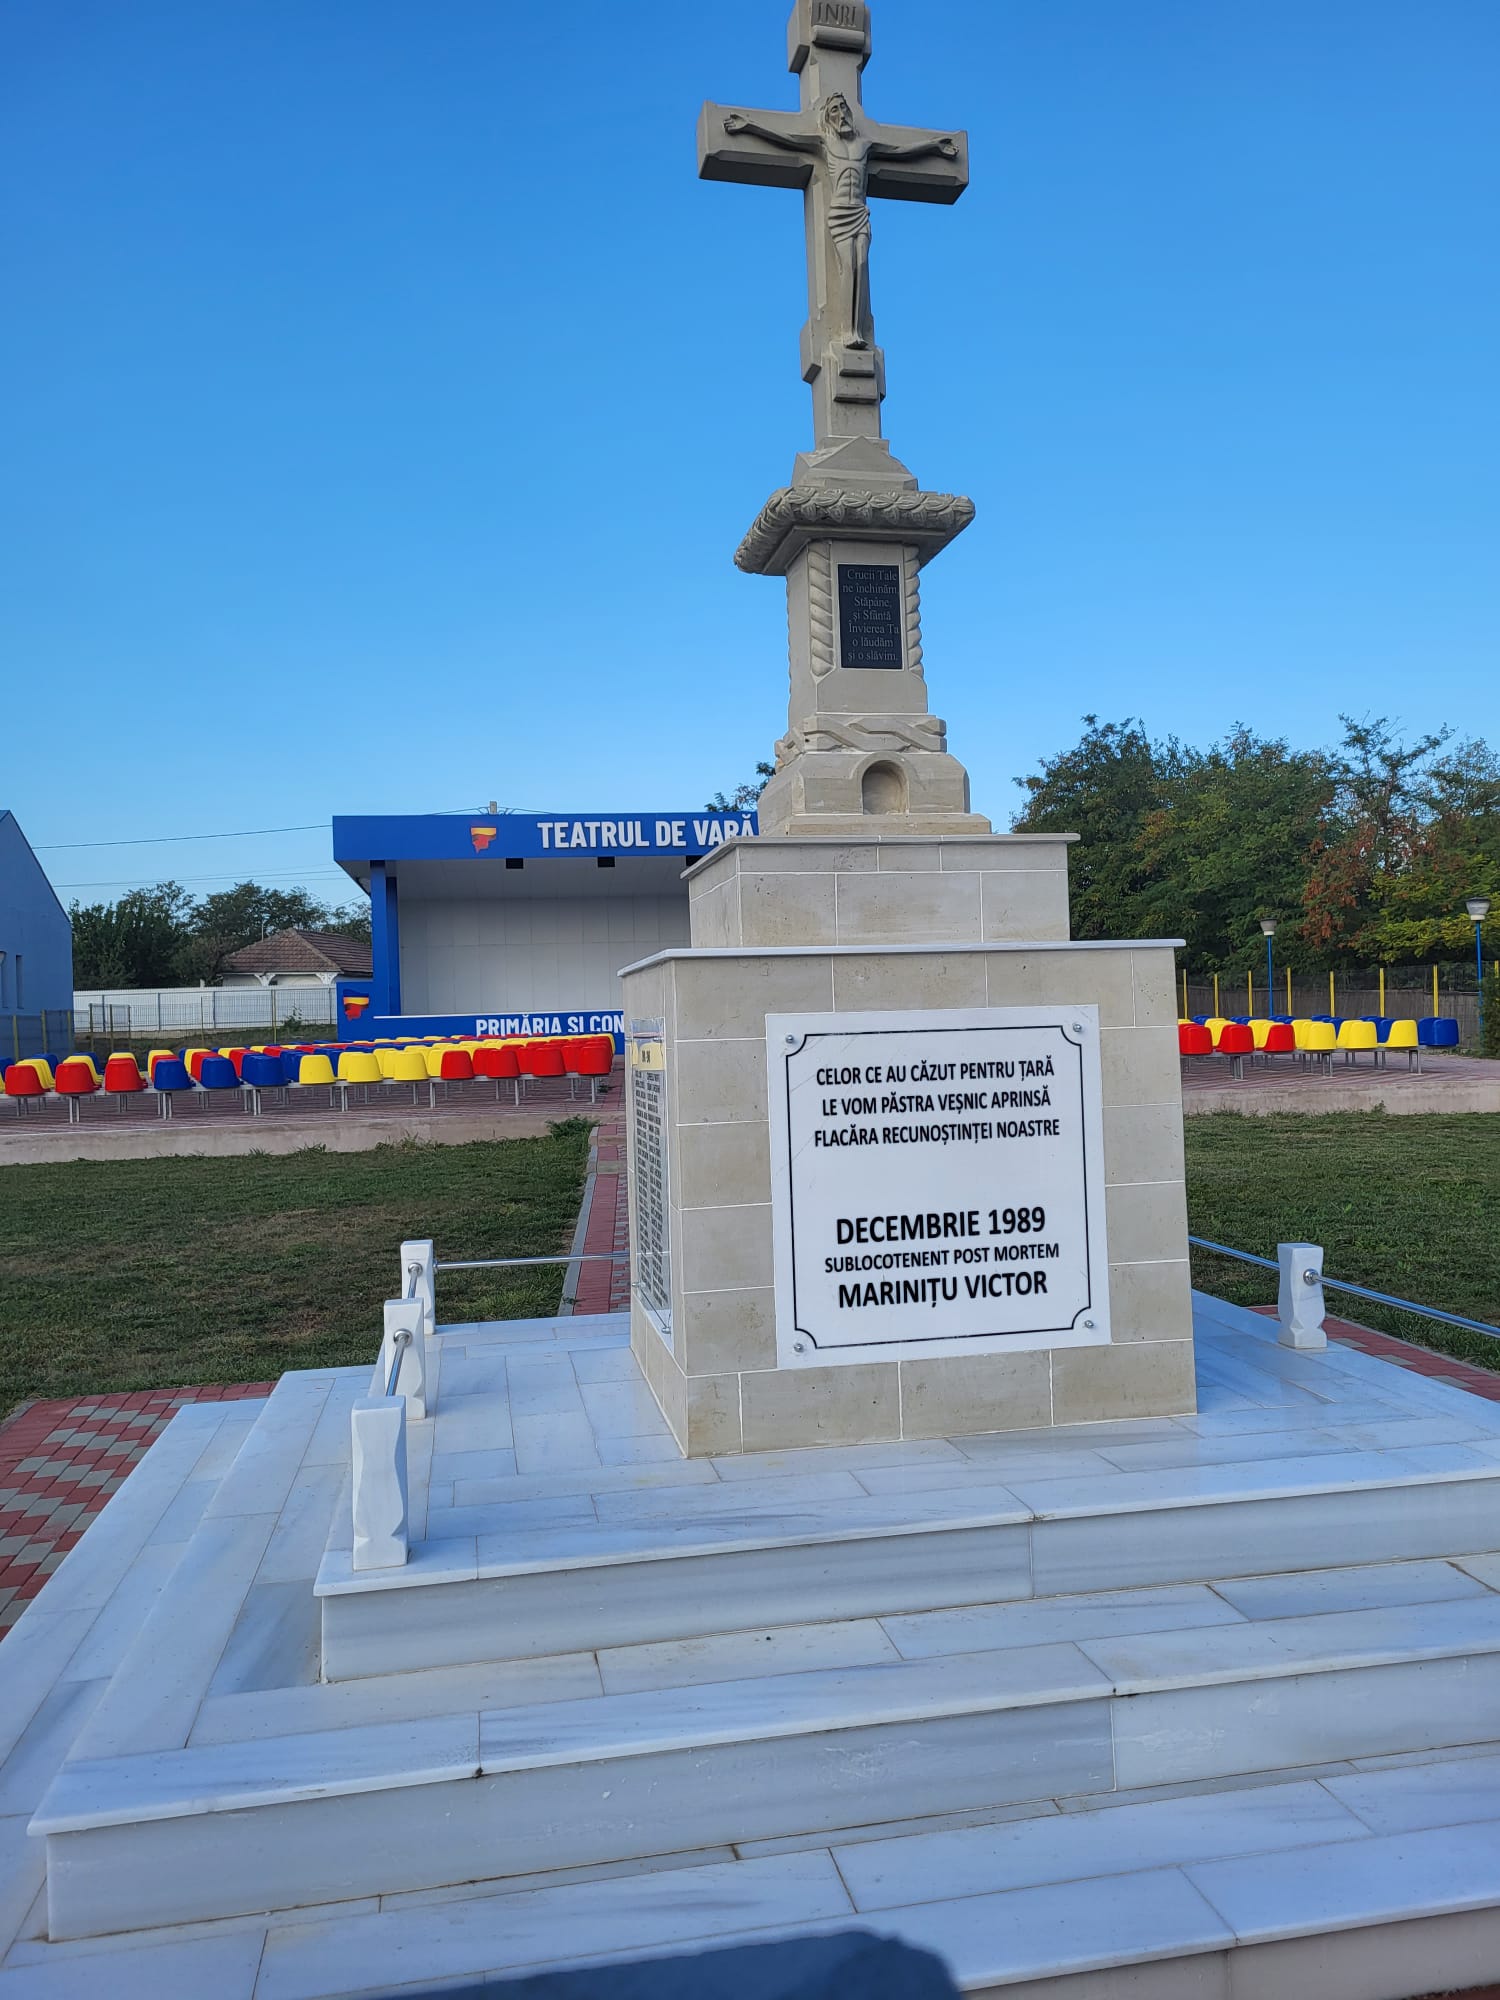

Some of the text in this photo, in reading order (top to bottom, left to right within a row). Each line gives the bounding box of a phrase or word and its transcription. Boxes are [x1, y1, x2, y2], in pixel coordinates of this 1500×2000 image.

[817, 2, 856, 26] INRI
[852, 638, 859, 647] o
[887, 623, 899, 634] Ta
[536, 813, 755, 849] TEATRUL DE VARĂ
[475, 1014, 562, 1038] PRIMĂRIA
[816, 1055, 1055, 1086] CELOR CE AU CĂZUT PENTRU ȚARĂ
[822, 1085, 1052, 1116] LE VOM PĂSTRA VEȘNIC APRINSĂ
[814, 1119, 1061, 1148] FLACĂRA RECUNOȘTINȚEI NOASTRE
[836, 1206, 1047, 1245] DECEMBRIE 1989
[824, 1243, 1060, 1273] SUBLOCOTENENT POST MORTEM
[838, 1270, 1049, 1309] MARINIȚU VICTOR
